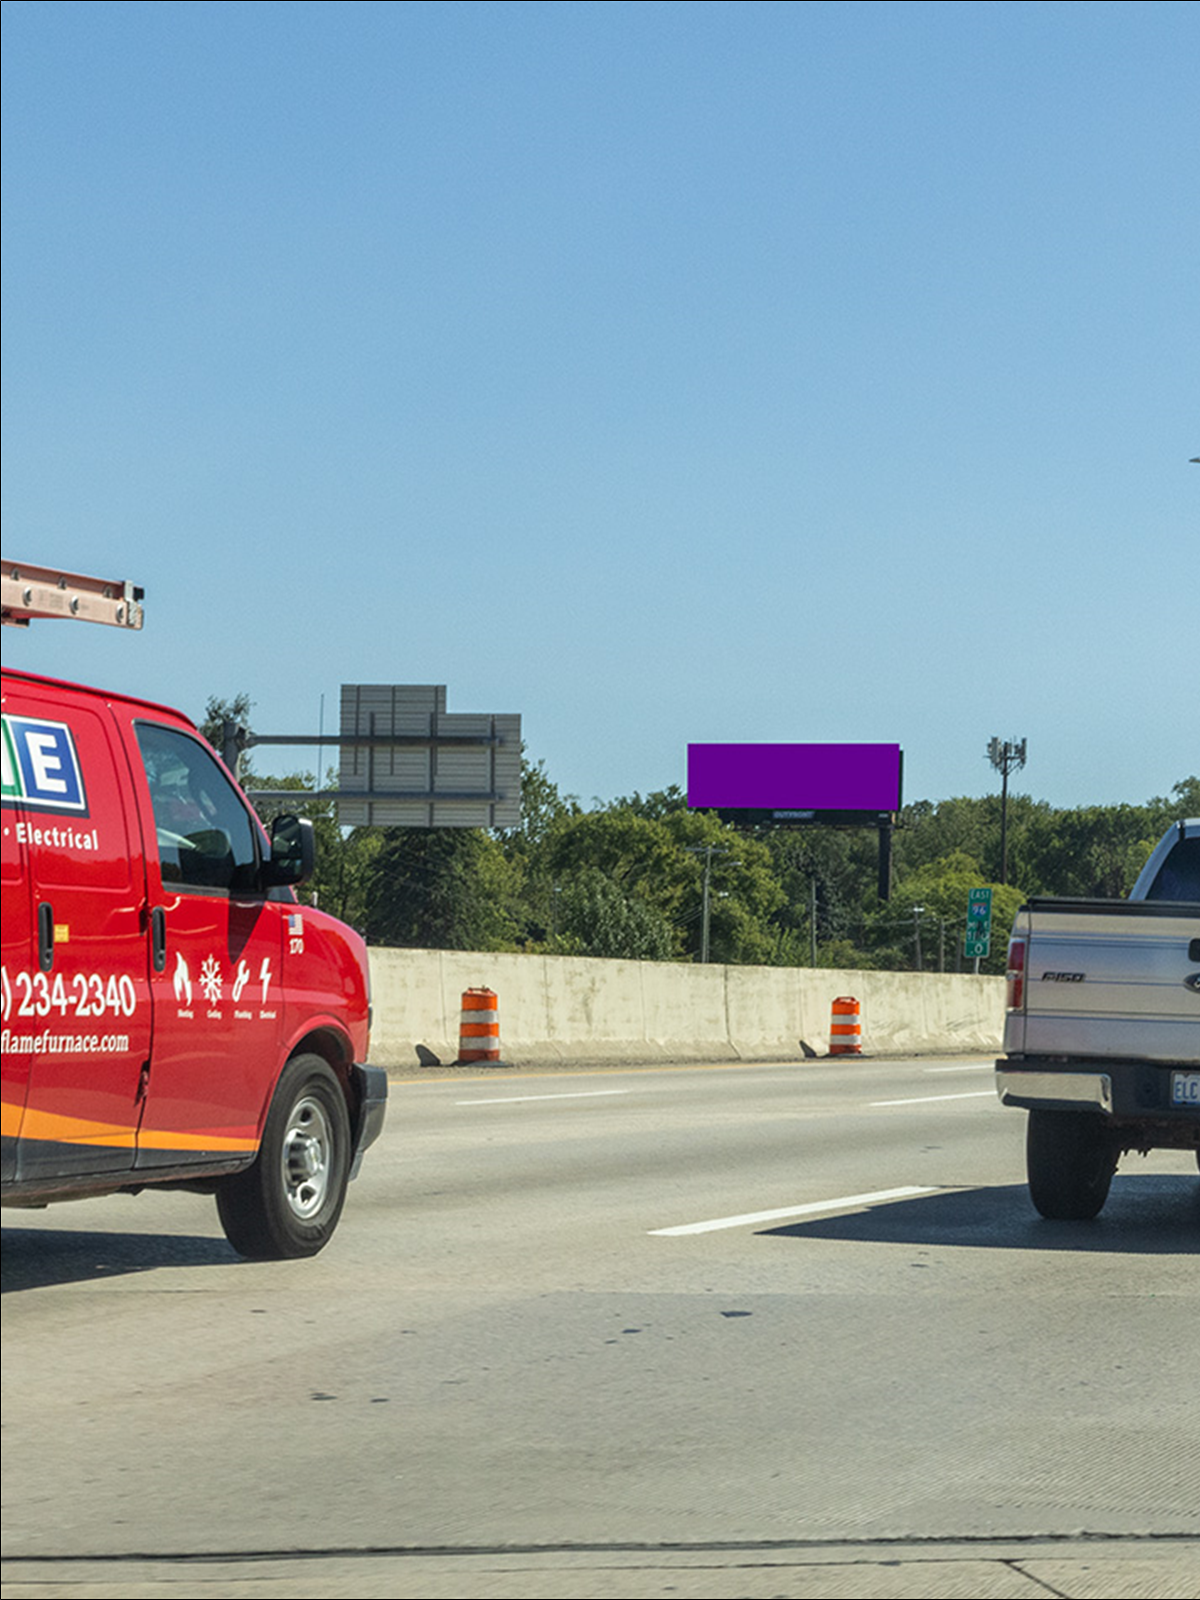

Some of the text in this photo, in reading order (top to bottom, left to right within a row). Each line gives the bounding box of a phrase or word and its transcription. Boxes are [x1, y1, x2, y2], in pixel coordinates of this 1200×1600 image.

[16, 822, 98, 851] Electrical
[970, 890, 989, 900] EAST
[972, 905, 987, 915] 96
[289, 938, 304, 954] 170
[16, 971, 136, 1017] 234-2340
[1174, 1081, 1198, 1100] ELC
